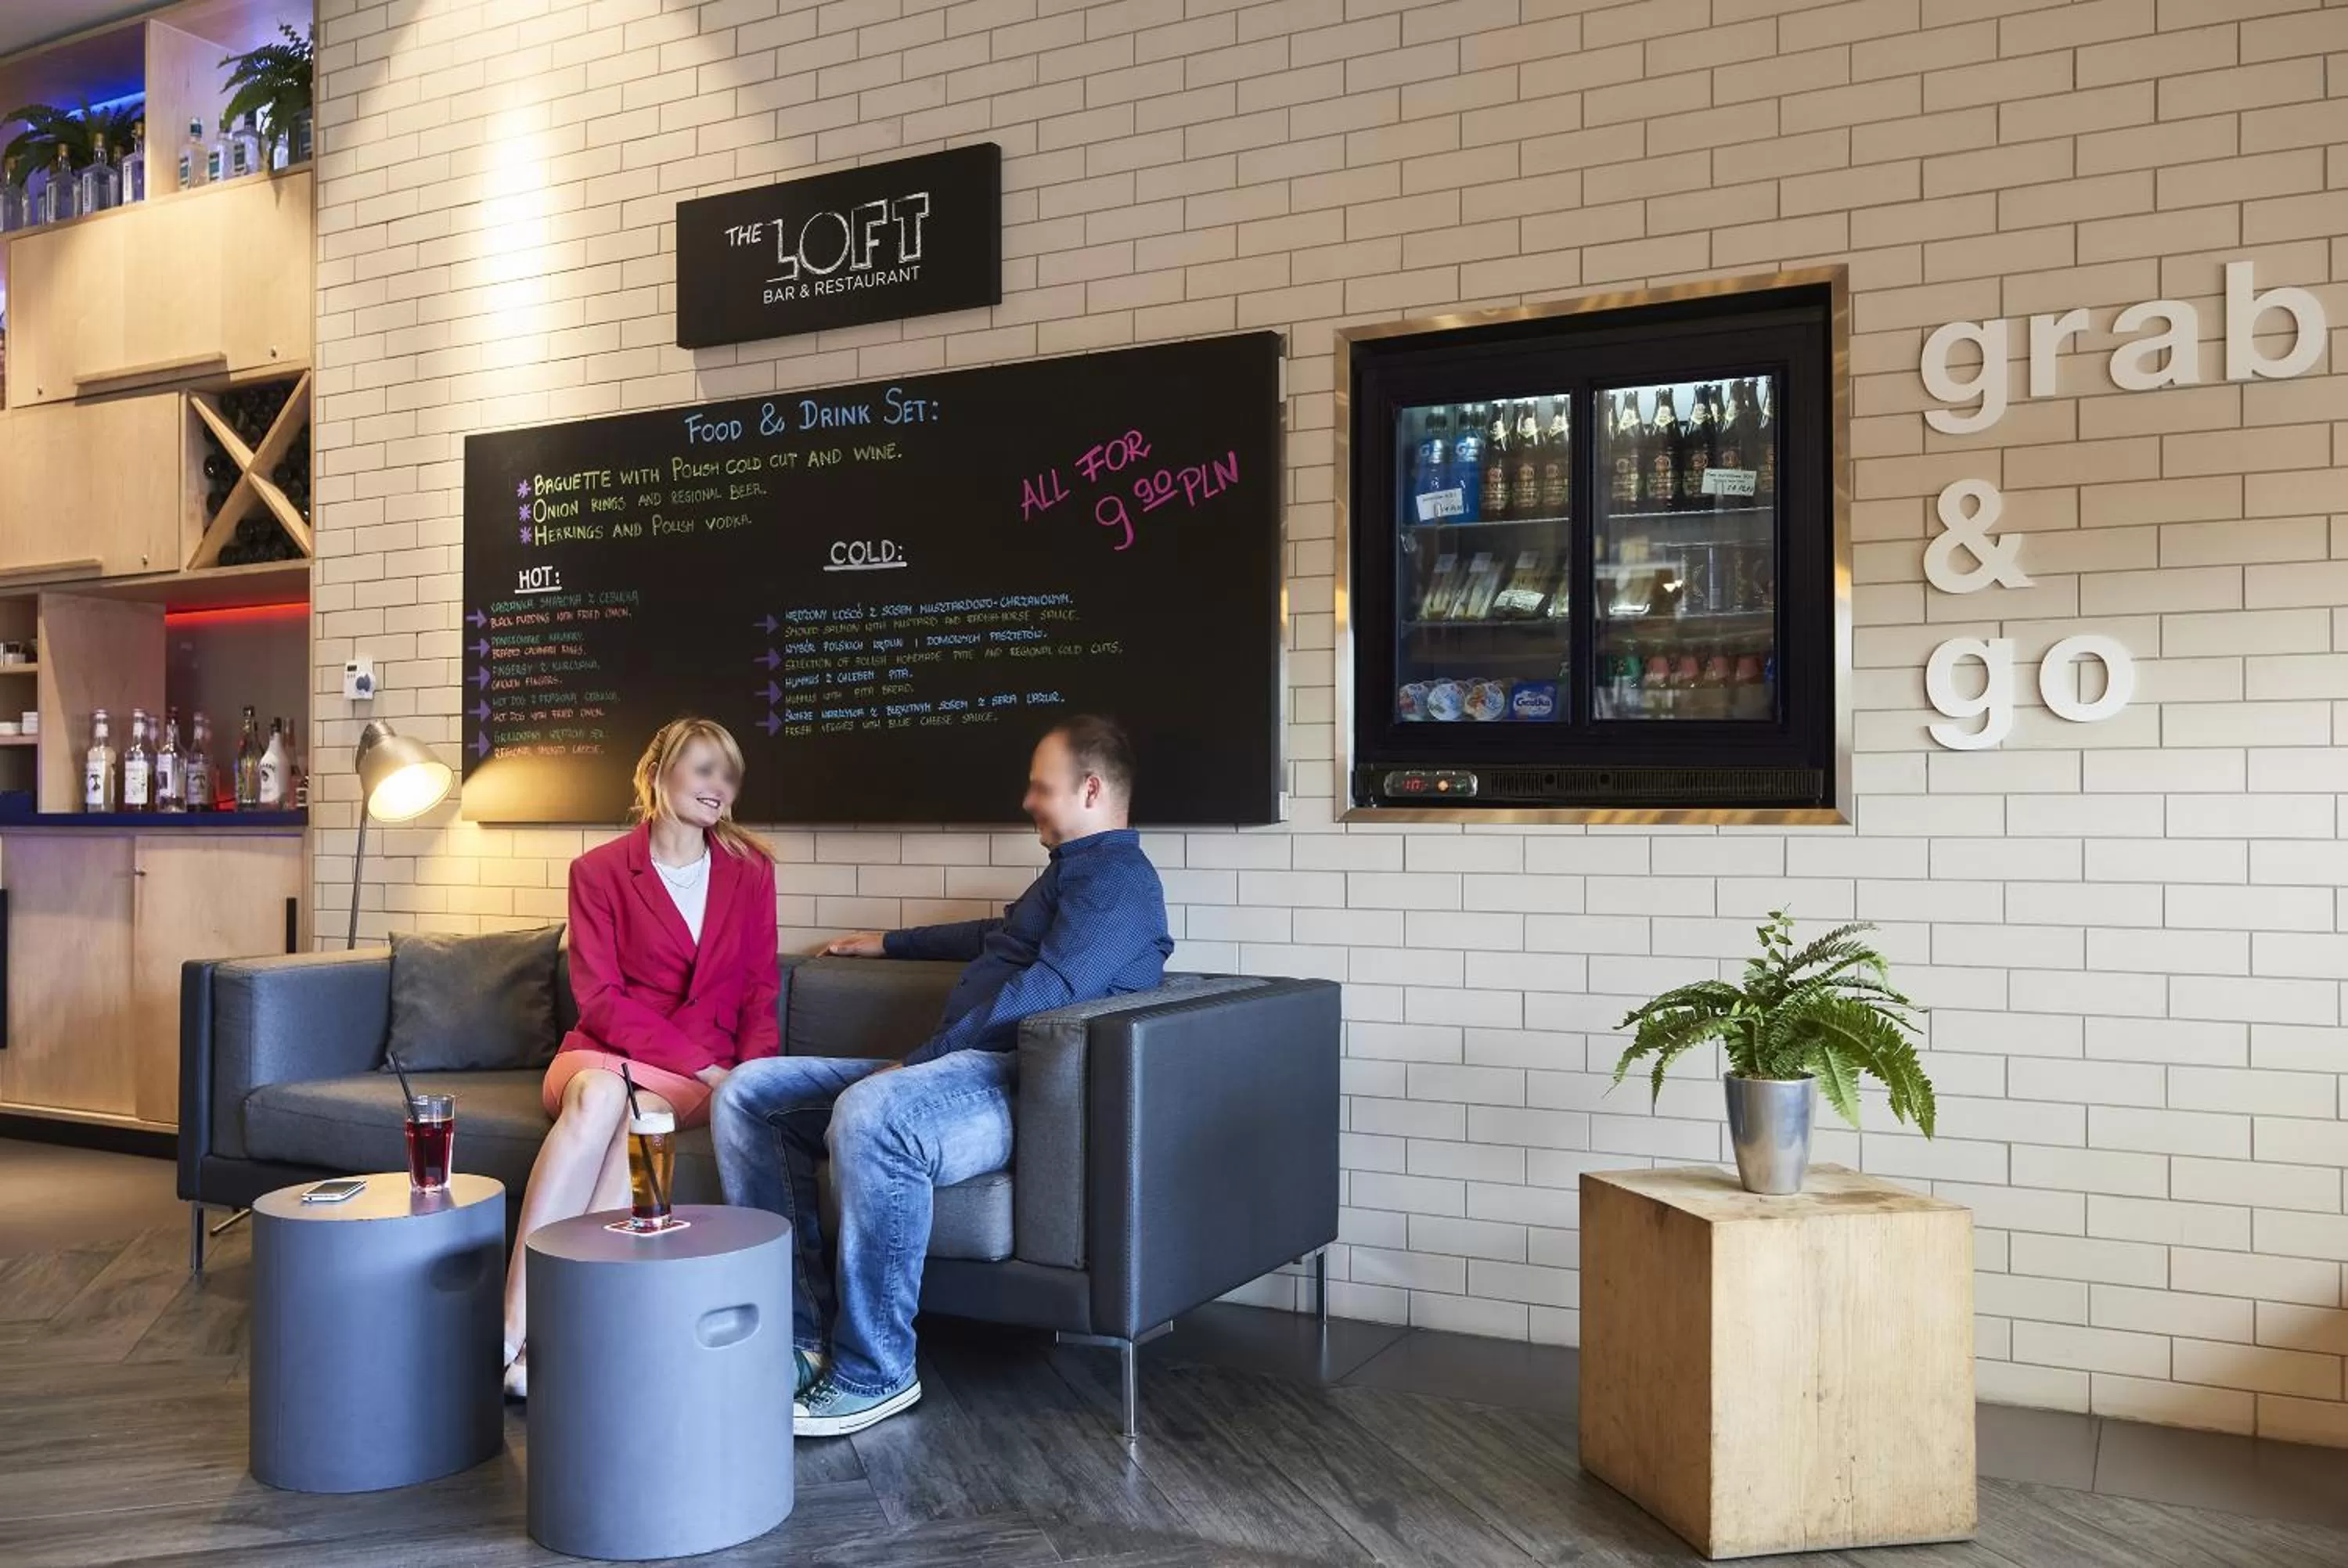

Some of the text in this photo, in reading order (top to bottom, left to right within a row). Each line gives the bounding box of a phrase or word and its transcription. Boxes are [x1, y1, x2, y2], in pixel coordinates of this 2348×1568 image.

[724, 191, 930, 282] THE LOFT
[762, 265, 920, 304] BAR & RESTAURANT
[1921, 261, 2327, 434] grab
[685, 413, 743, 445] FOOD
[759, 401, 786, 437] &
[798, 399, 871, 430] DRINK
[620, 468, 661, 486] WITH
[726, 458, 762, 475] COLD
[769, 451, 798, 469] CUT
[808, 447, 843, 466] AND
[854, 441, 902, 463] WINE.
[1021, 430, 1152, 521] ALL FOR
[1176, 451, 1239, 507] PLN
[591, 495, 626, 514] RINGS
[638, 491, 662, 507] AND
[671, 484, 722, 504] REGIONAL
[729, 480, 767, 499] BEER.
[534, 523, 604, 546] HERRINGS
[612, 520, 643, 539] AND
[830, 539, 906, 566] COLD:
[1923, 479, 2035, 594] &
[518, 566, 561, 589] HOT:
[1926, 635, 2133, 750] go
